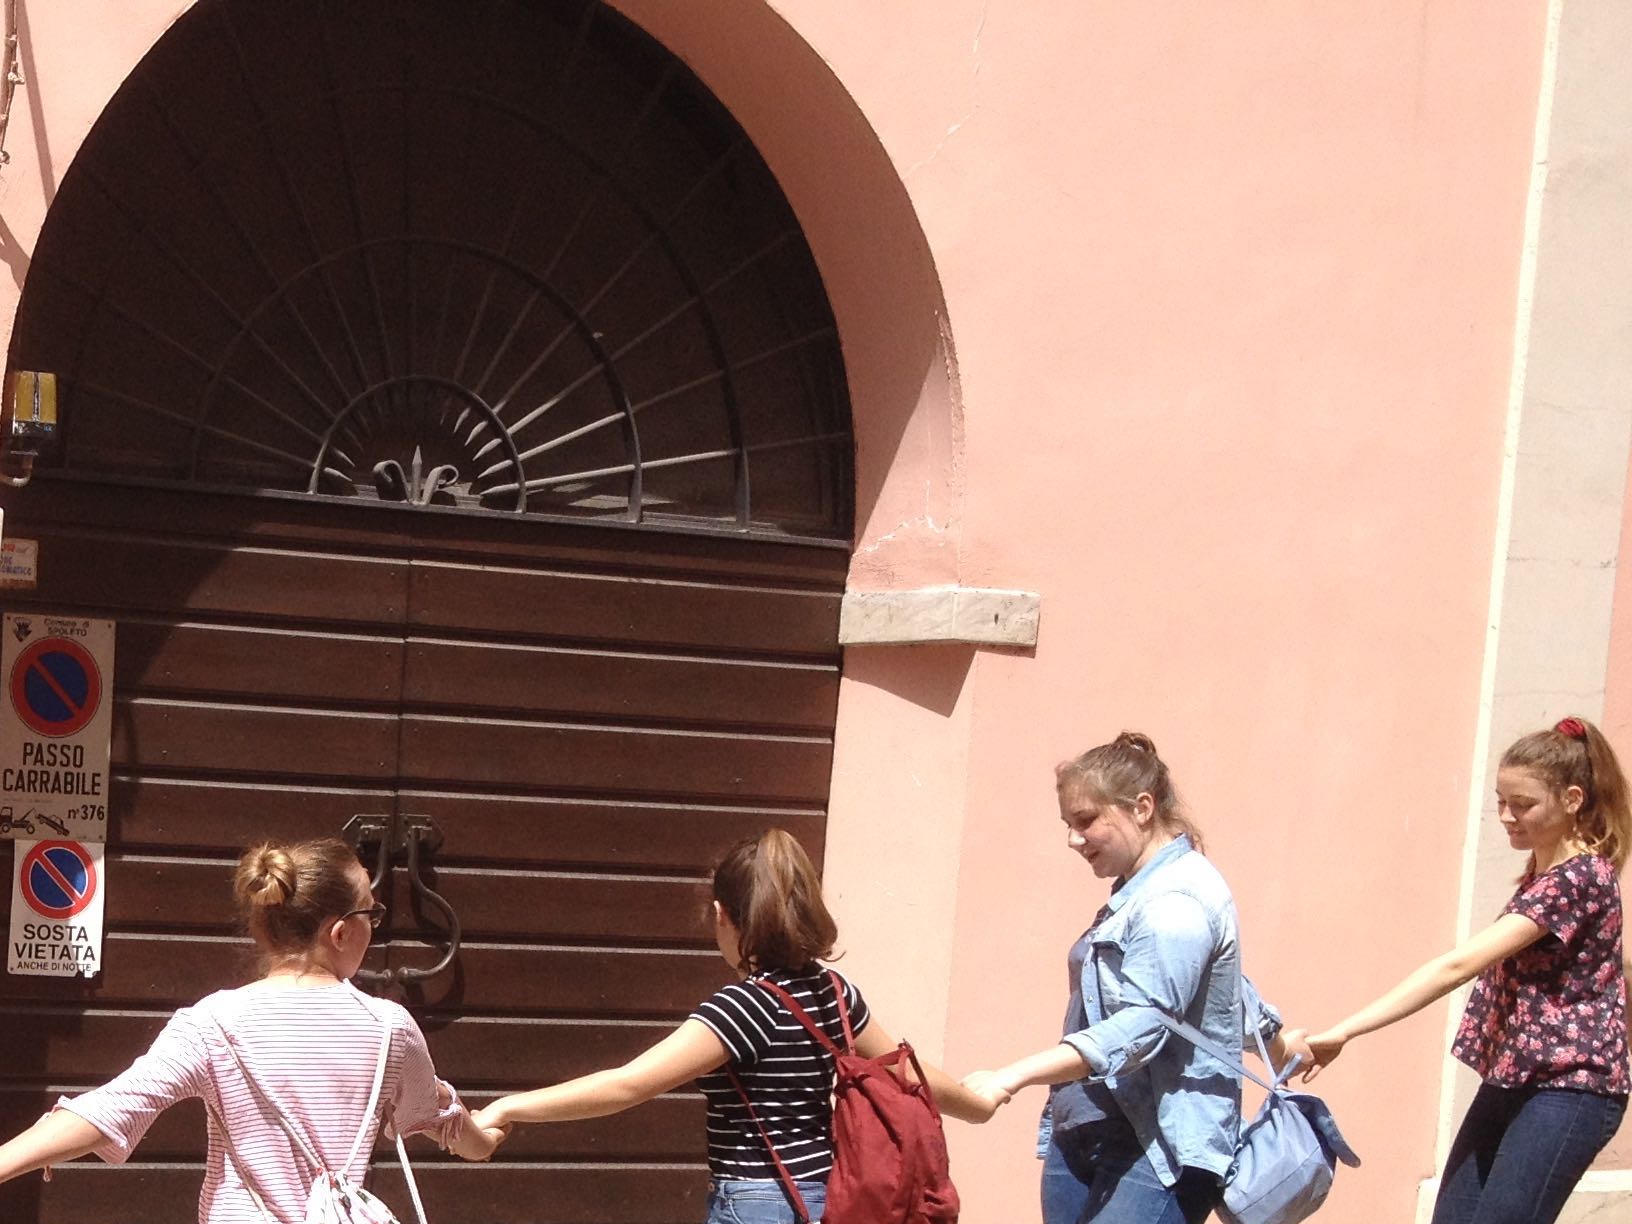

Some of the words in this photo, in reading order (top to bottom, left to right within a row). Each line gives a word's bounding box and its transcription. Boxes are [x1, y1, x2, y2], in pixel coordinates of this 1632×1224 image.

[23, 742, 84, 768] PASSO
[2, 768, 101, 795] CARRABILE
[23, 923, 89, 942] SOSTA
[14, 942, 96, 961] VIETATA
[17, 961, 49, 970] ANCHE
[51, 963, 61, 971] DI
[62, 963, 92, 972] NOTTE
